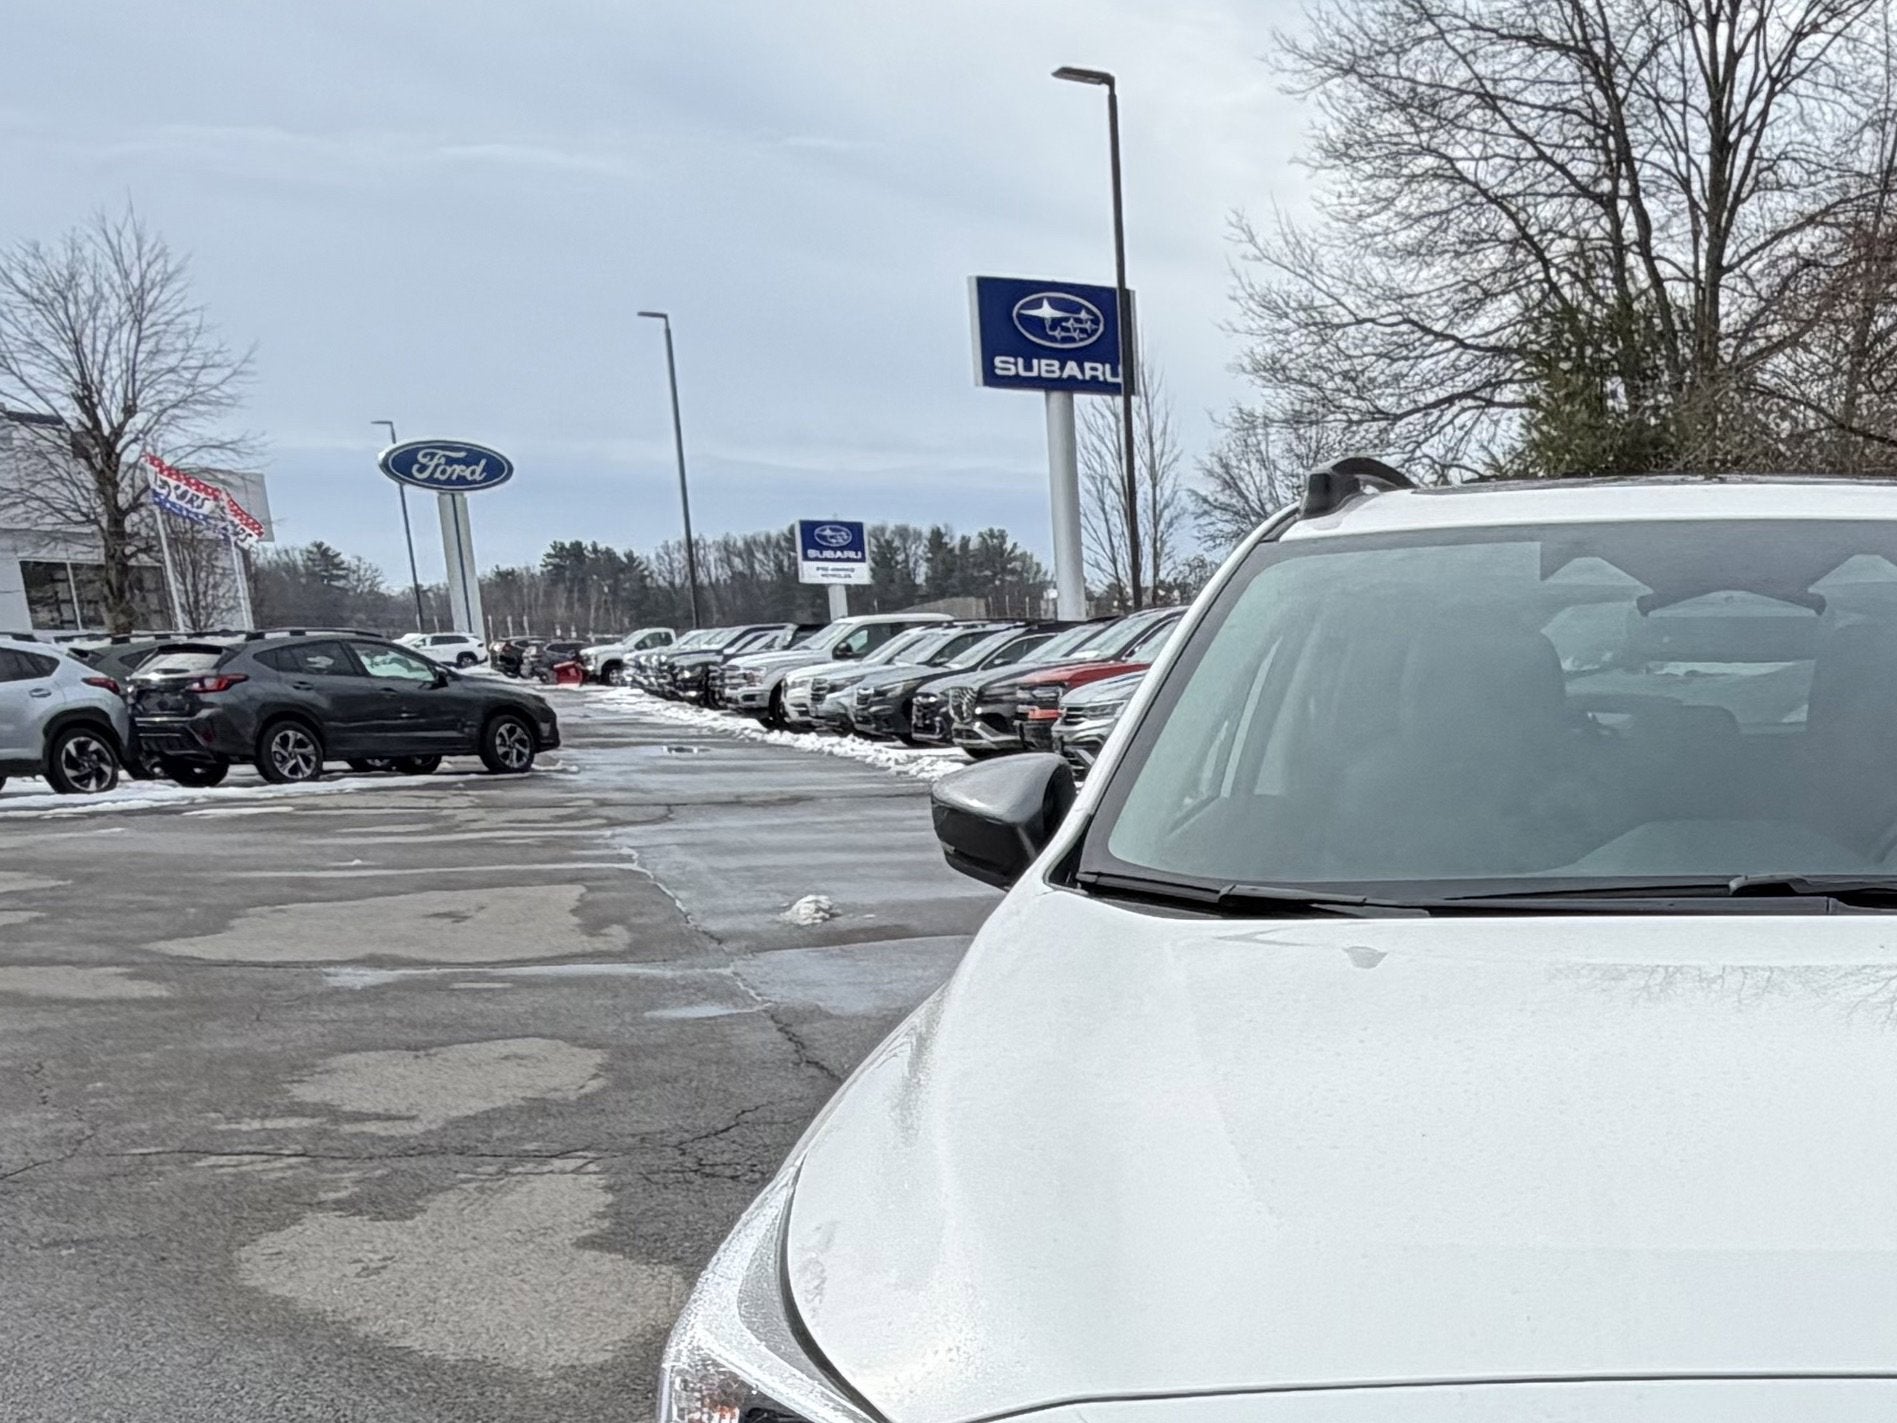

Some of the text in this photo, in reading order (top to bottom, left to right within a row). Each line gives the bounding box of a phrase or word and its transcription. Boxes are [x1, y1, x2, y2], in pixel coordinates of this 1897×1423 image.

[993, 355, 1122, 384] SUBARU
[411, 448, 487, 481] Ford
[807, 548, 862, 560] SUBARU
